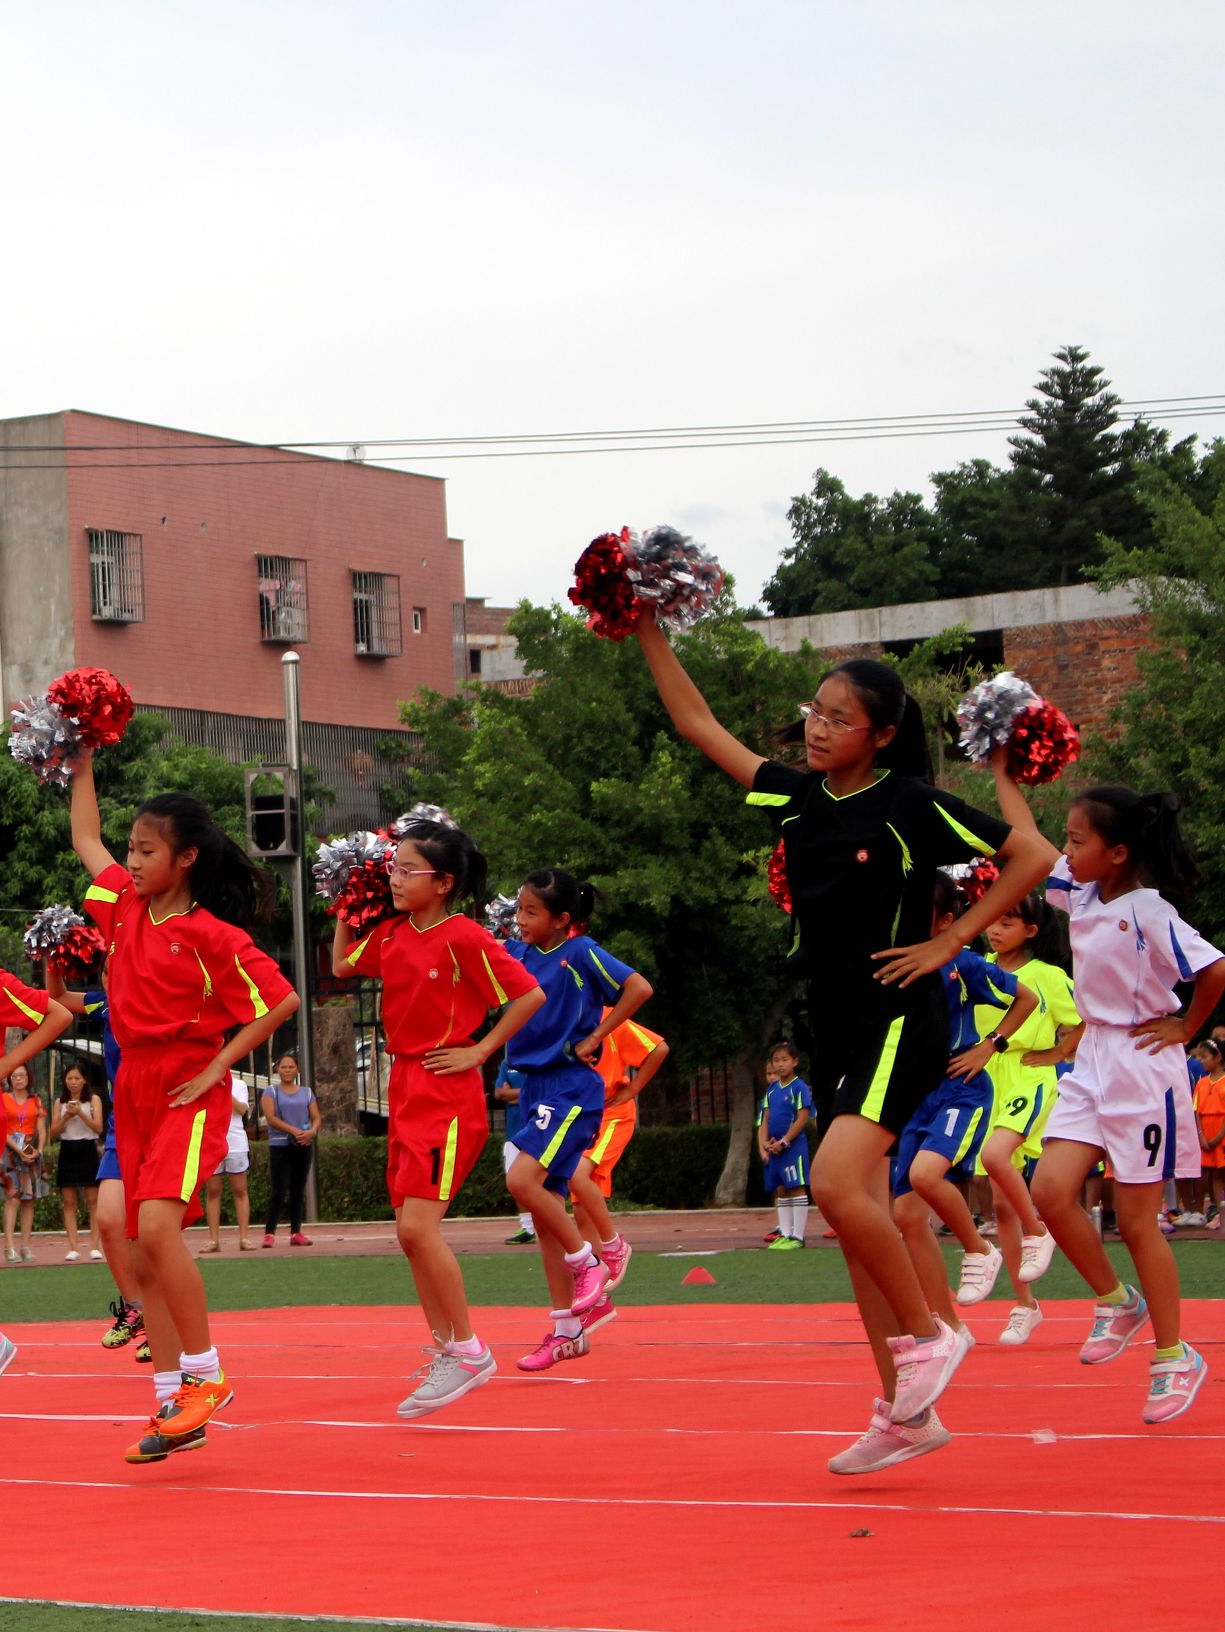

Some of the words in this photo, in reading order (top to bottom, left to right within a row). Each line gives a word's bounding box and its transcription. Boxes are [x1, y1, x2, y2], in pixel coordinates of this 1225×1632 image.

[536, 1104, 555, 1130] 5
[944, 1108, 960, 1137] 1
[1143, 1123, 1162, 1167] 9
[430, 1147, 441, 1186] 1
[785, 1165, 797, 1182] 11
